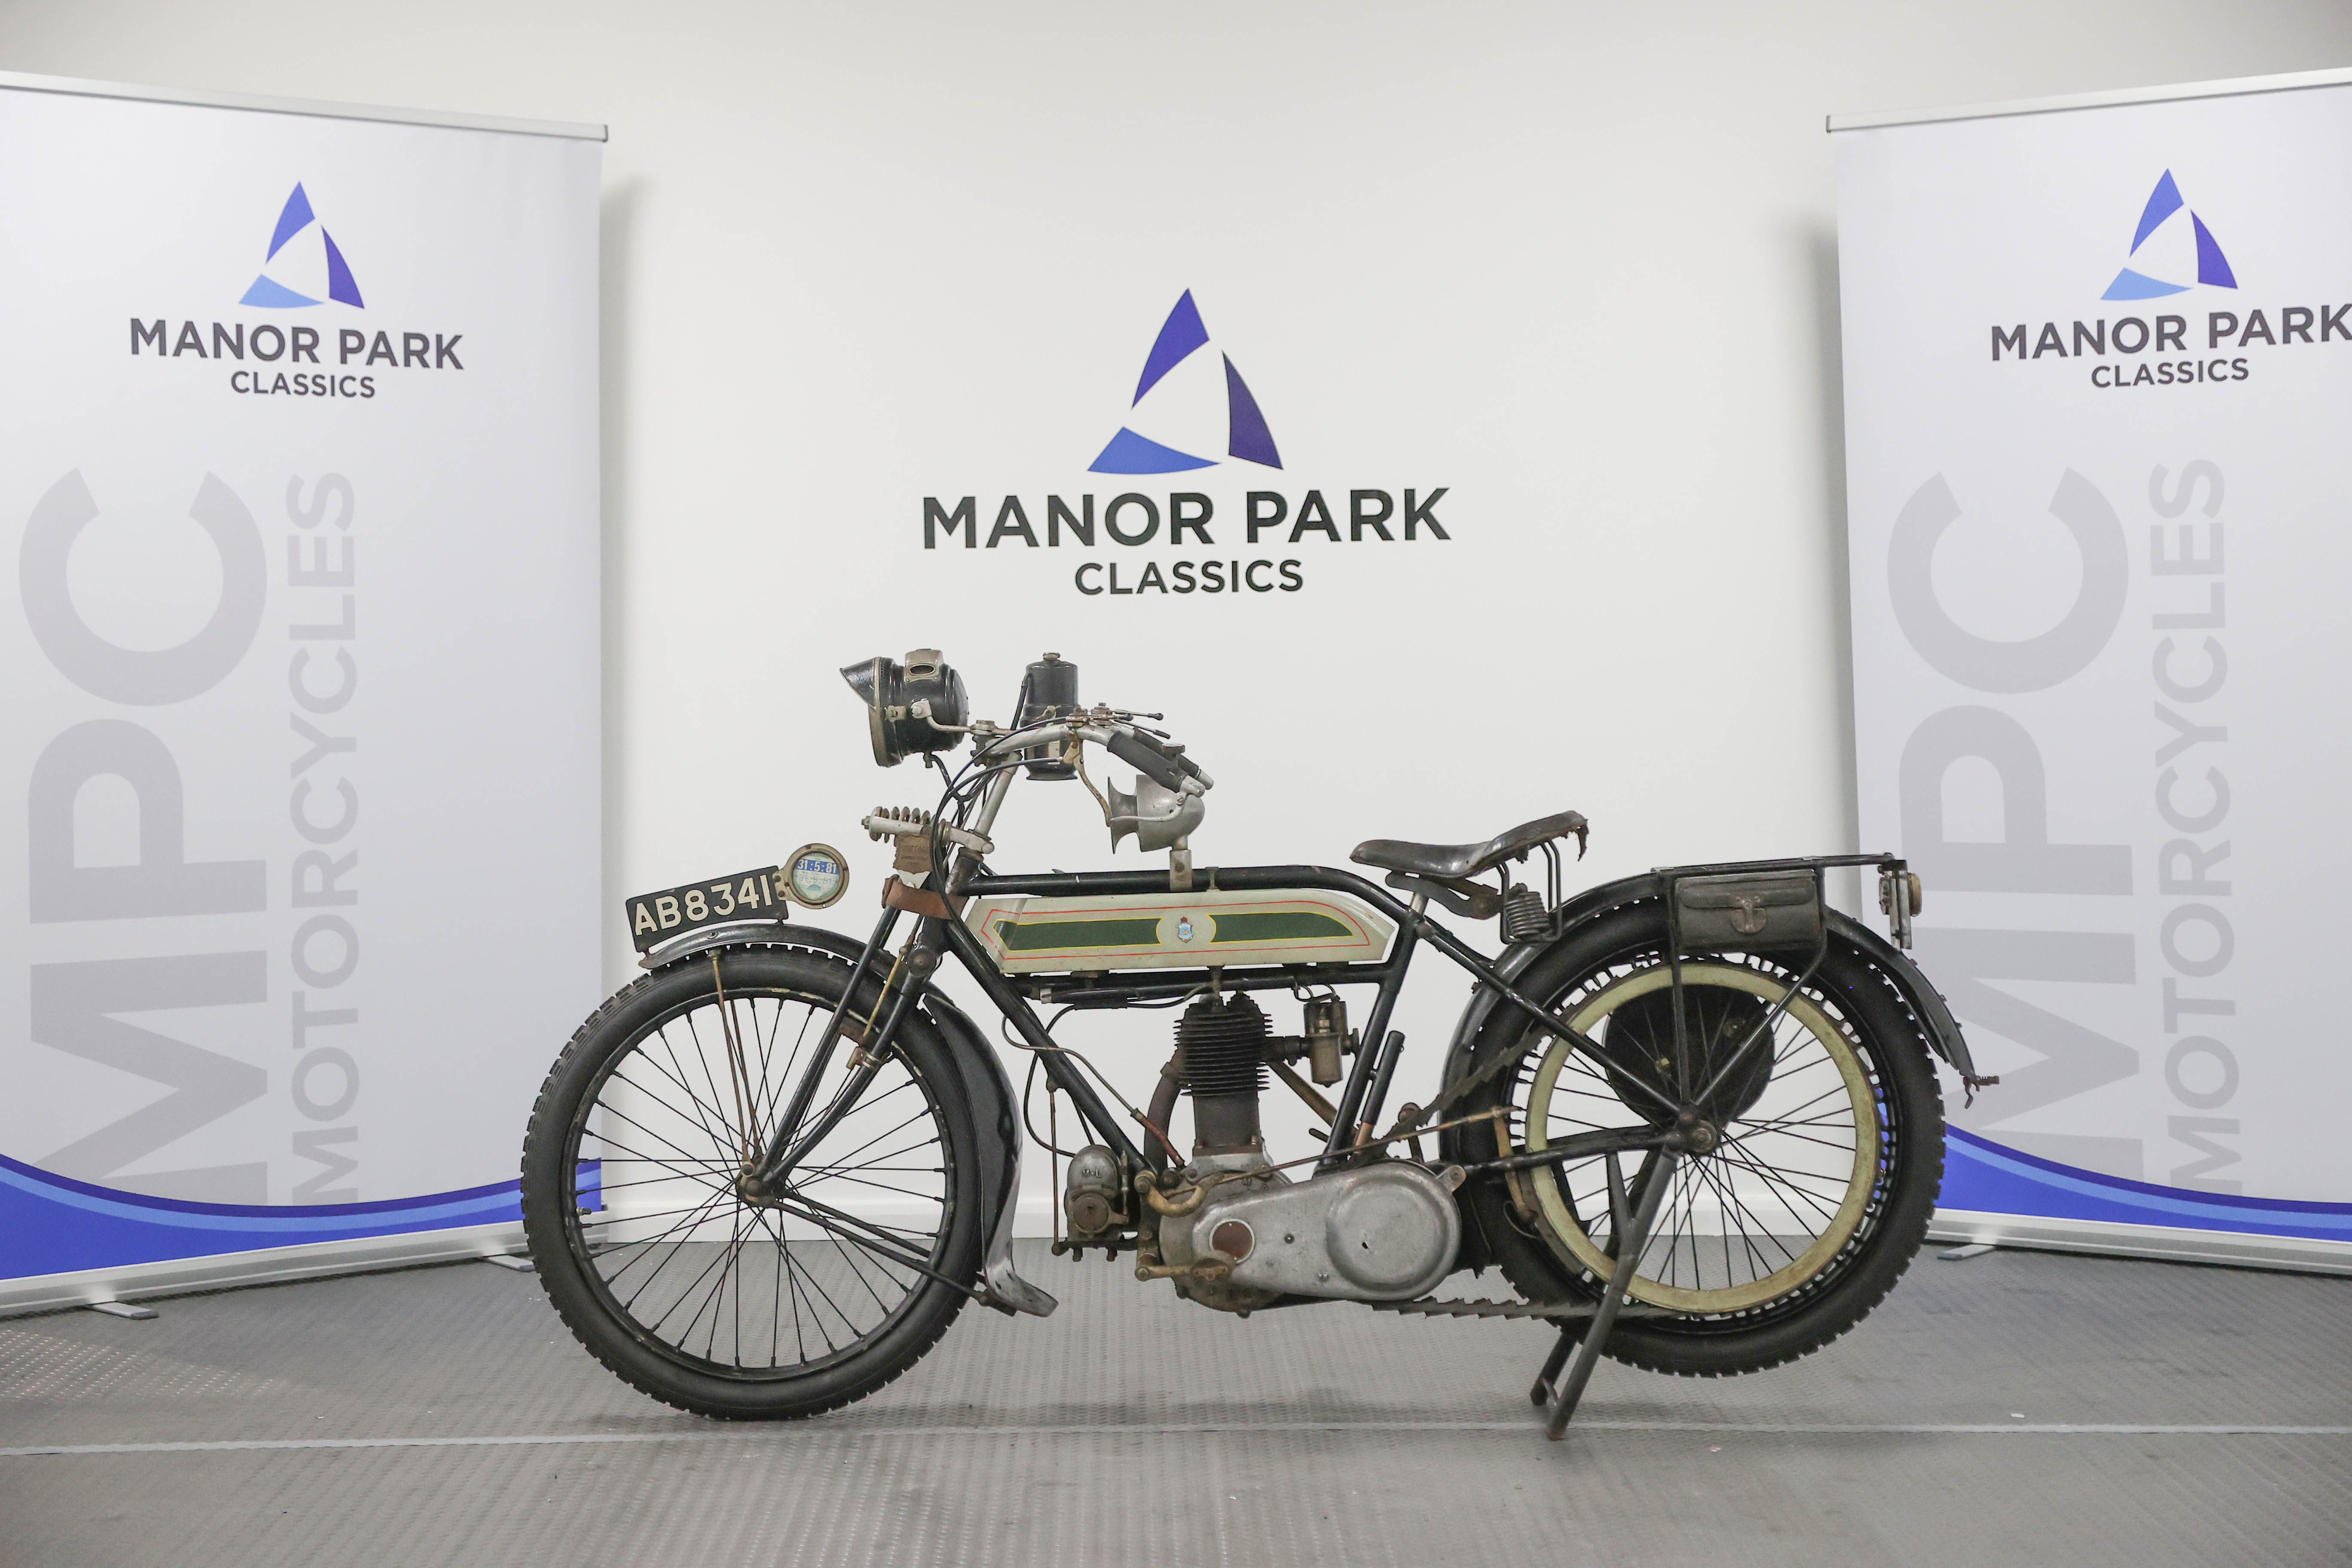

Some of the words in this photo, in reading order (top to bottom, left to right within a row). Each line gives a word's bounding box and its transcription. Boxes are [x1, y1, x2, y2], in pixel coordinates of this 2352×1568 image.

[130, 318, 320, 364] MANOR
[340, 329, 464, 370] PARK
[1991, 315, 2187, 361] MANOR
[2208, 303, 2352, 349] PARK
[231, 371, 375, 398] CLASSICS
[2091, 358, 2249, 388] CLASSICS
[923, 492, 1215, 550] MANOR
[1246, 487, 1452, 544] PARK
[1075, 559, 1304, 596] CLASSICS
[19, 467, 267, 1206] MPC
[285, 471, 359, 1206] MOTORCYCLES
[1887, 466, 2145, 1181] MPC
[2148, 459, 2243, 1197] MOTORCYCLES
[797, 859, 837, 874] 31:5:81
[635, 874, 772, 936] AB8341
